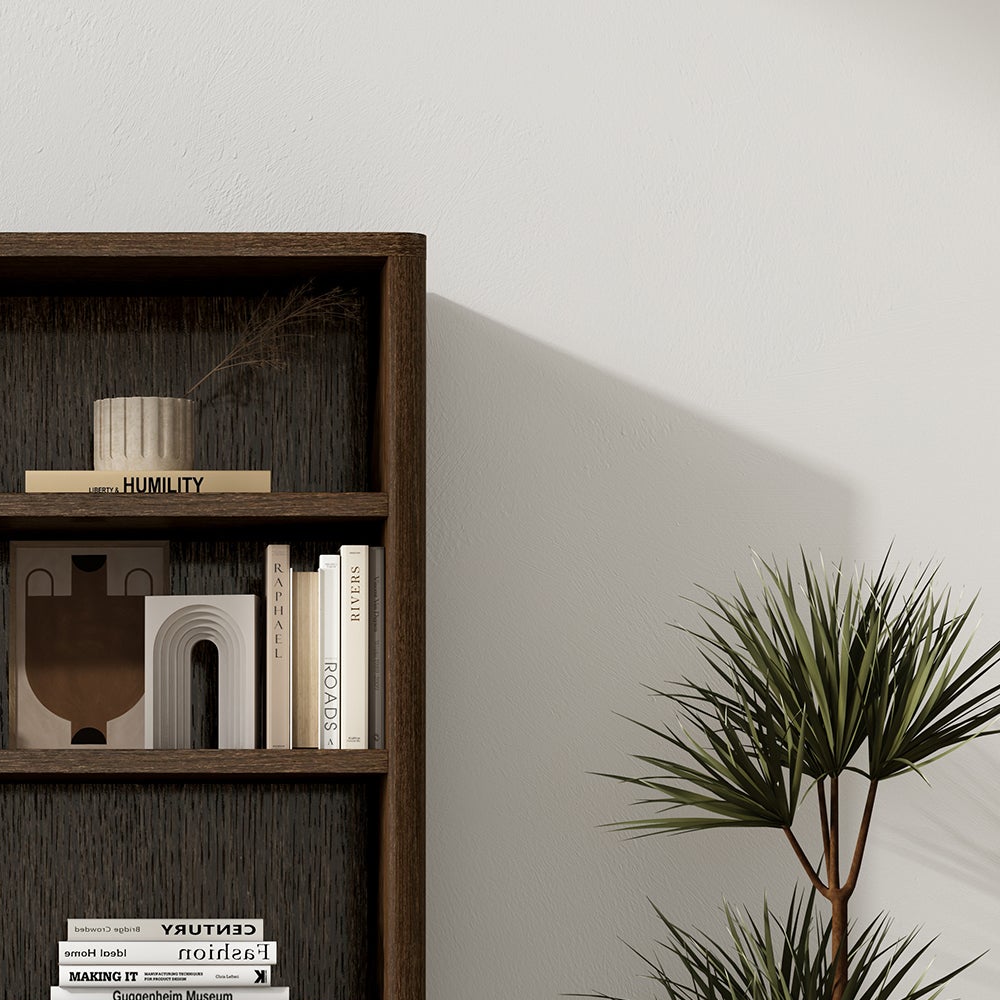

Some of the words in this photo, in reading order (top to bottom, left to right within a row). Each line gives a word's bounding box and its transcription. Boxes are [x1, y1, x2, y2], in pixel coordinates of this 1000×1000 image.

[123, 477, 204, 493] HUMILITY
[274, 563, 283, 659] RAPHAEL
[351, 566, 360, 622] RIVERS
[324, 662, 338, 731] ROADS
[69, 972, 122, 981] MAKING
[124, 972, 138, 981] IT
